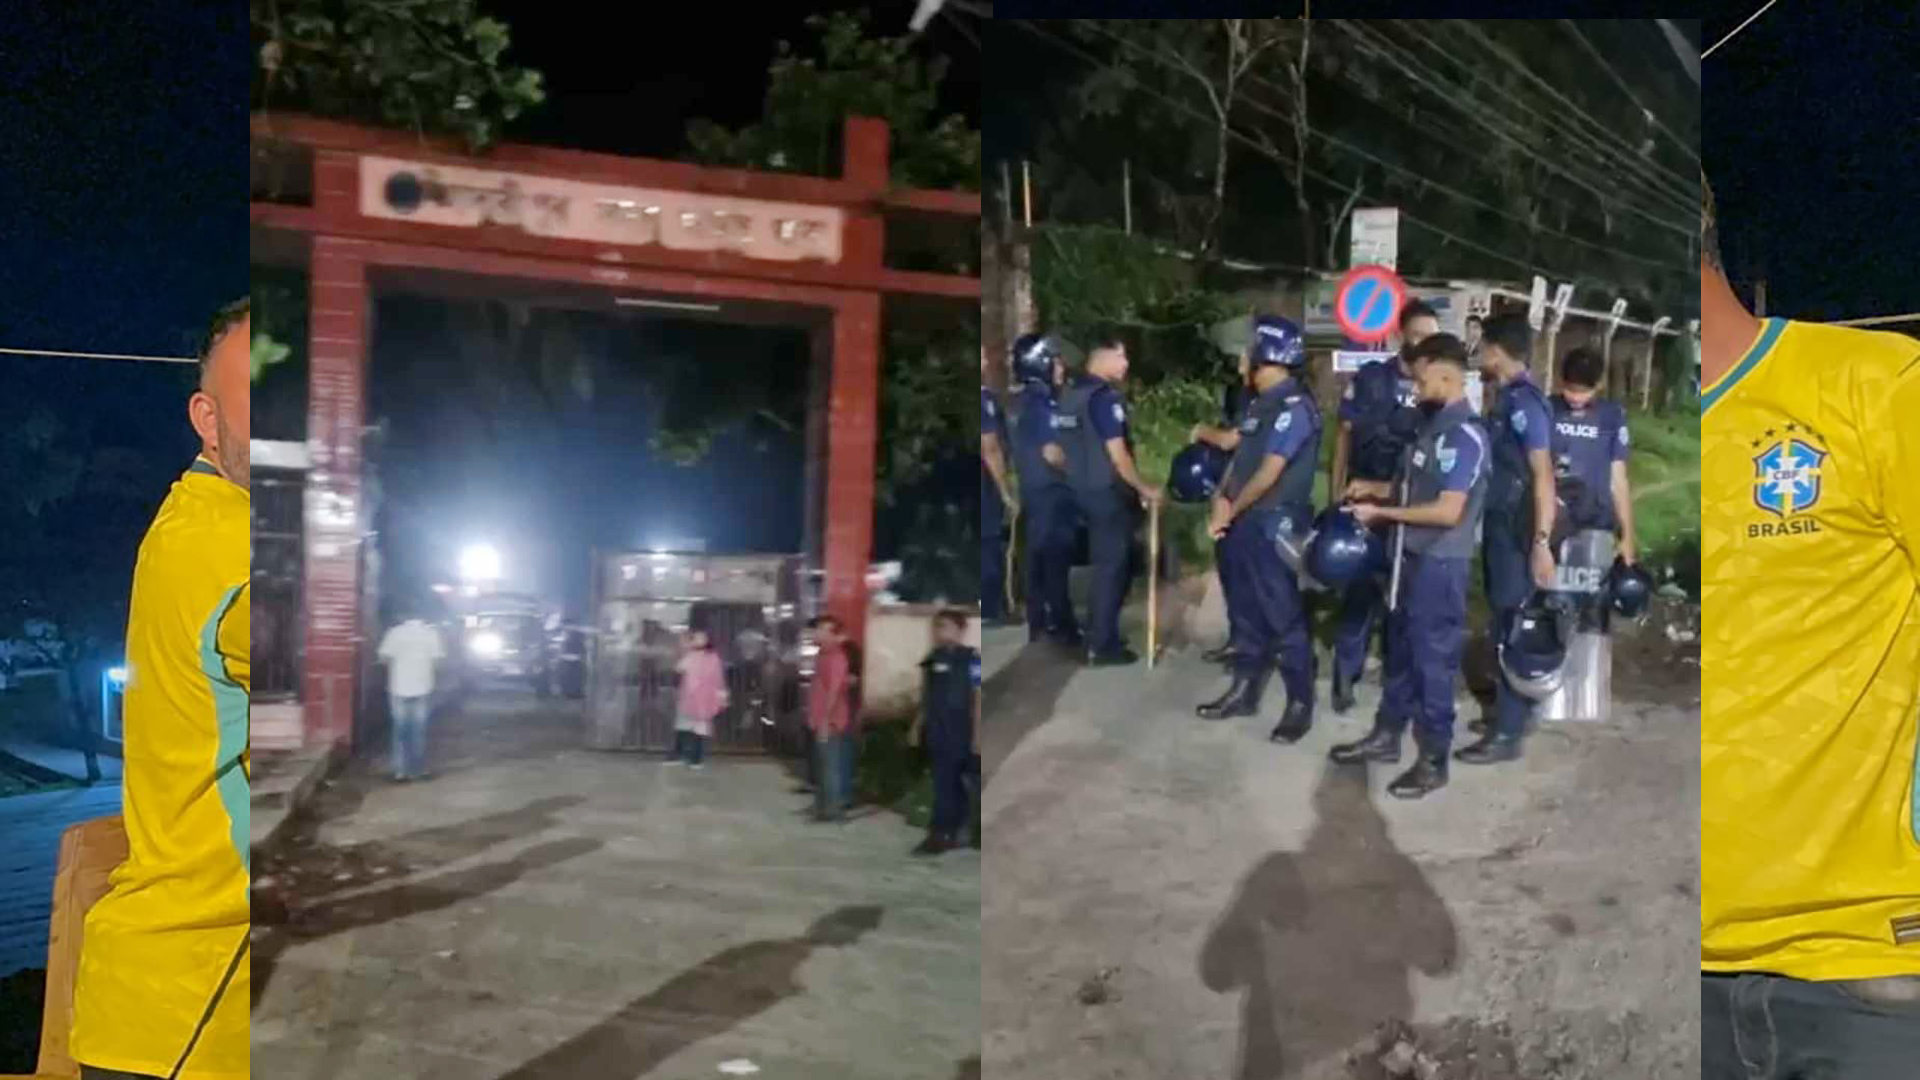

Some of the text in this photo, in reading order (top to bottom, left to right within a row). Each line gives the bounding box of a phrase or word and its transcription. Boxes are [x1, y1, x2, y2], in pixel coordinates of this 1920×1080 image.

[1555, 423, 1598, 438] POLICE
[1773, 470, 1800, 481] CBF
[1747, 519, 1822, 538] BRASIL
[1556, 566, 1602, 594] LICE
